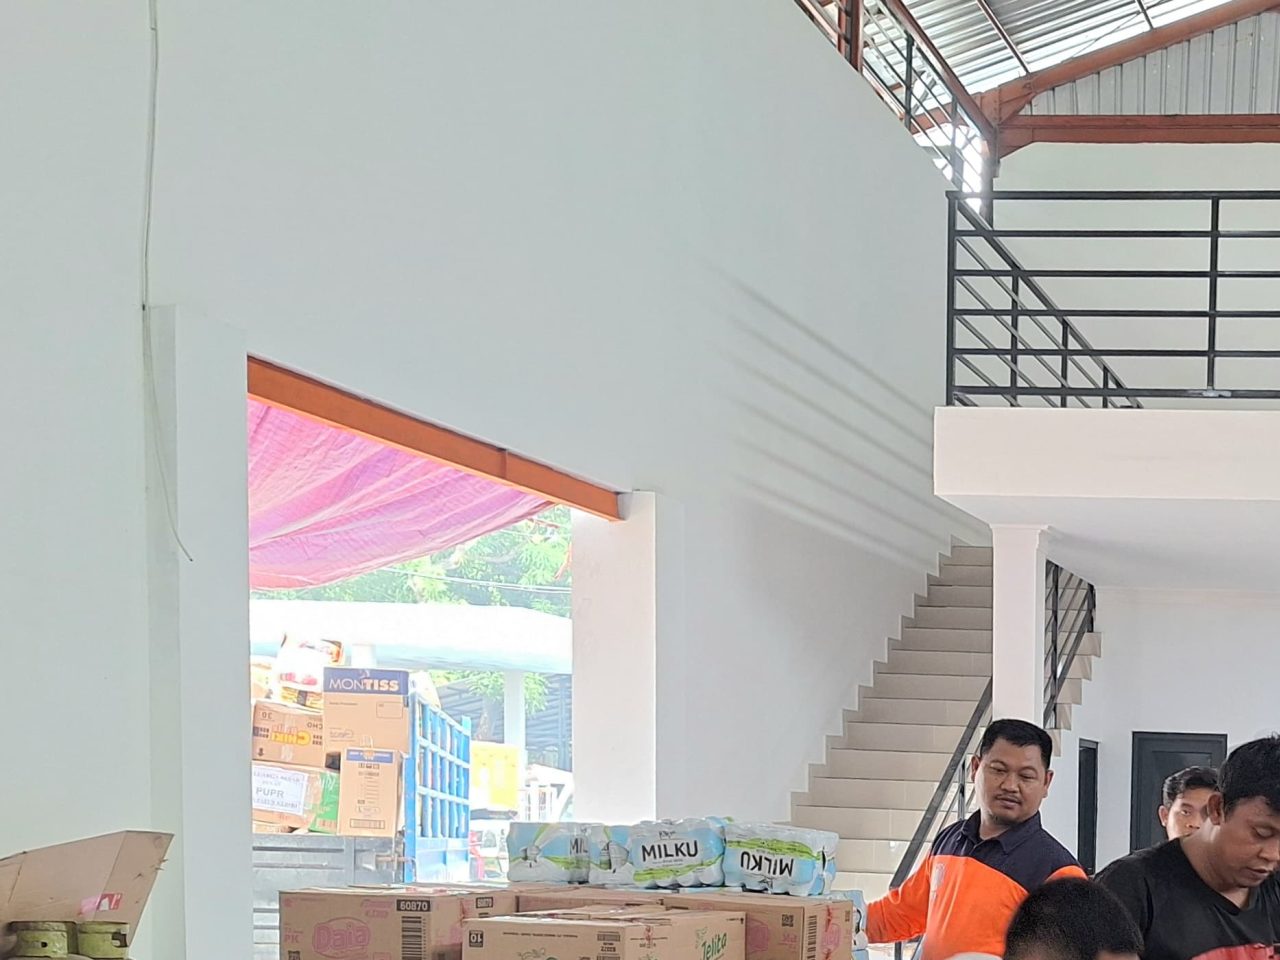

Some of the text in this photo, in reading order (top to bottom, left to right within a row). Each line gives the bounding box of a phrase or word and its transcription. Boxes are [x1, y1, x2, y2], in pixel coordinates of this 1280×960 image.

[329, 678, 399, 691] MONTISS
[255, 786, 285, 798] PUPR
[641, 840, 699, 862] MILKU
[740, 851, 794, 877] MILKU
[400, 901, 428, 911] 60870
[313, 924, 370, 950] Daia
